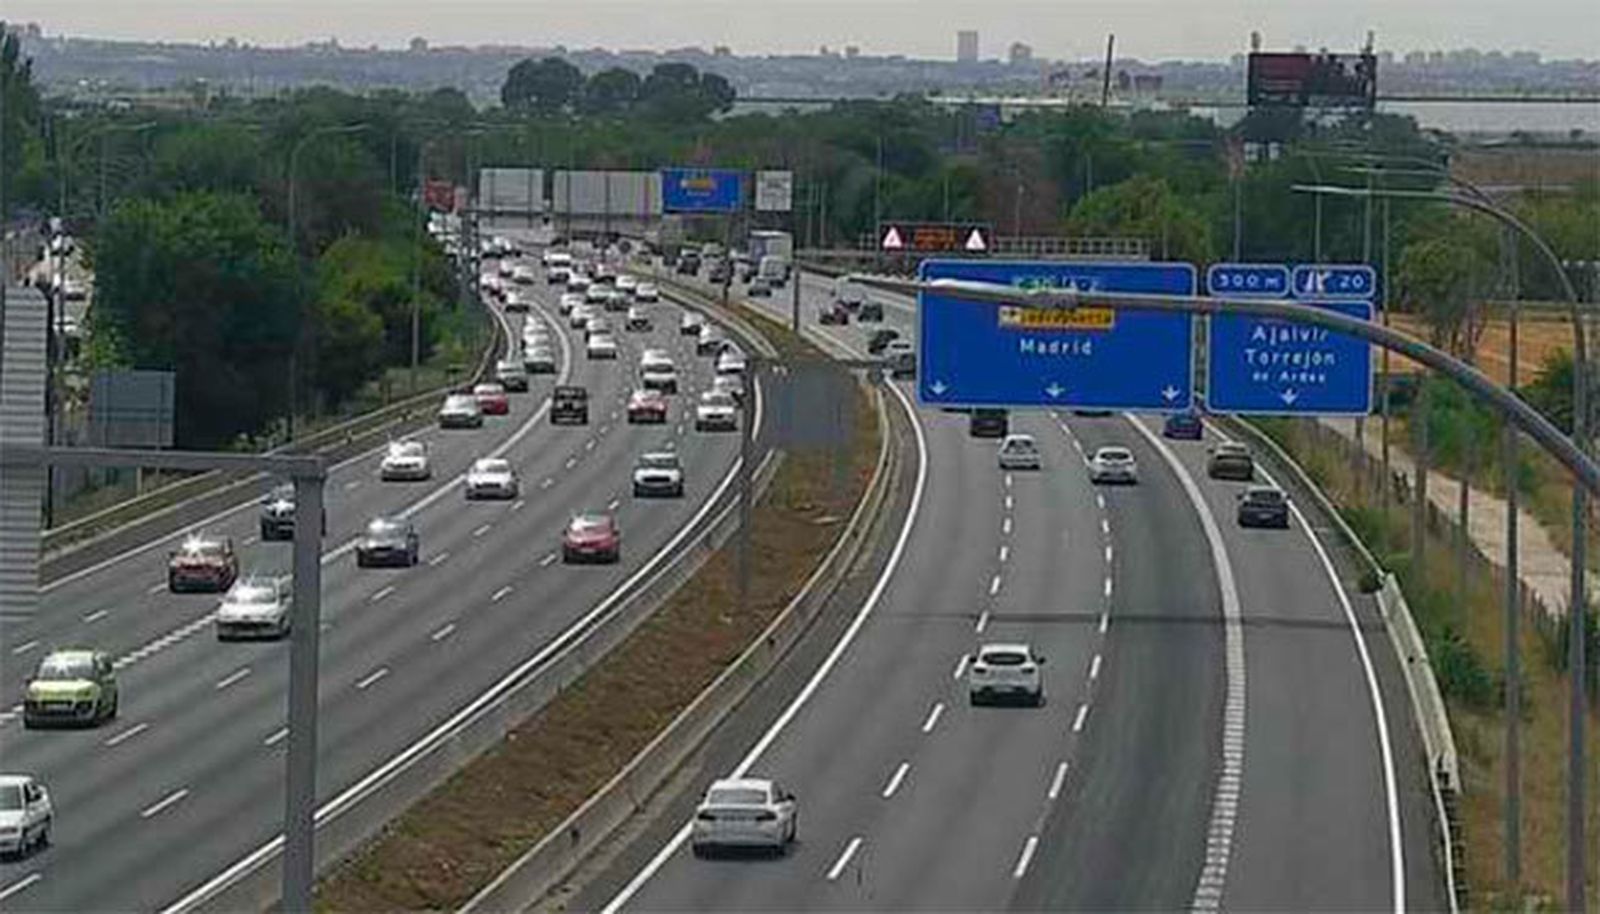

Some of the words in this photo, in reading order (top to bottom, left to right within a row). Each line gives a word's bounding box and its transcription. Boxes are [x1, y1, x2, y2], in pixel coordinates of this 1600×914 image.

[1340, 274, 1364, 288] 20
[1252, 325, 1329, 346] Ajalvir
[1019, 338, 1093, 355] Madrid
